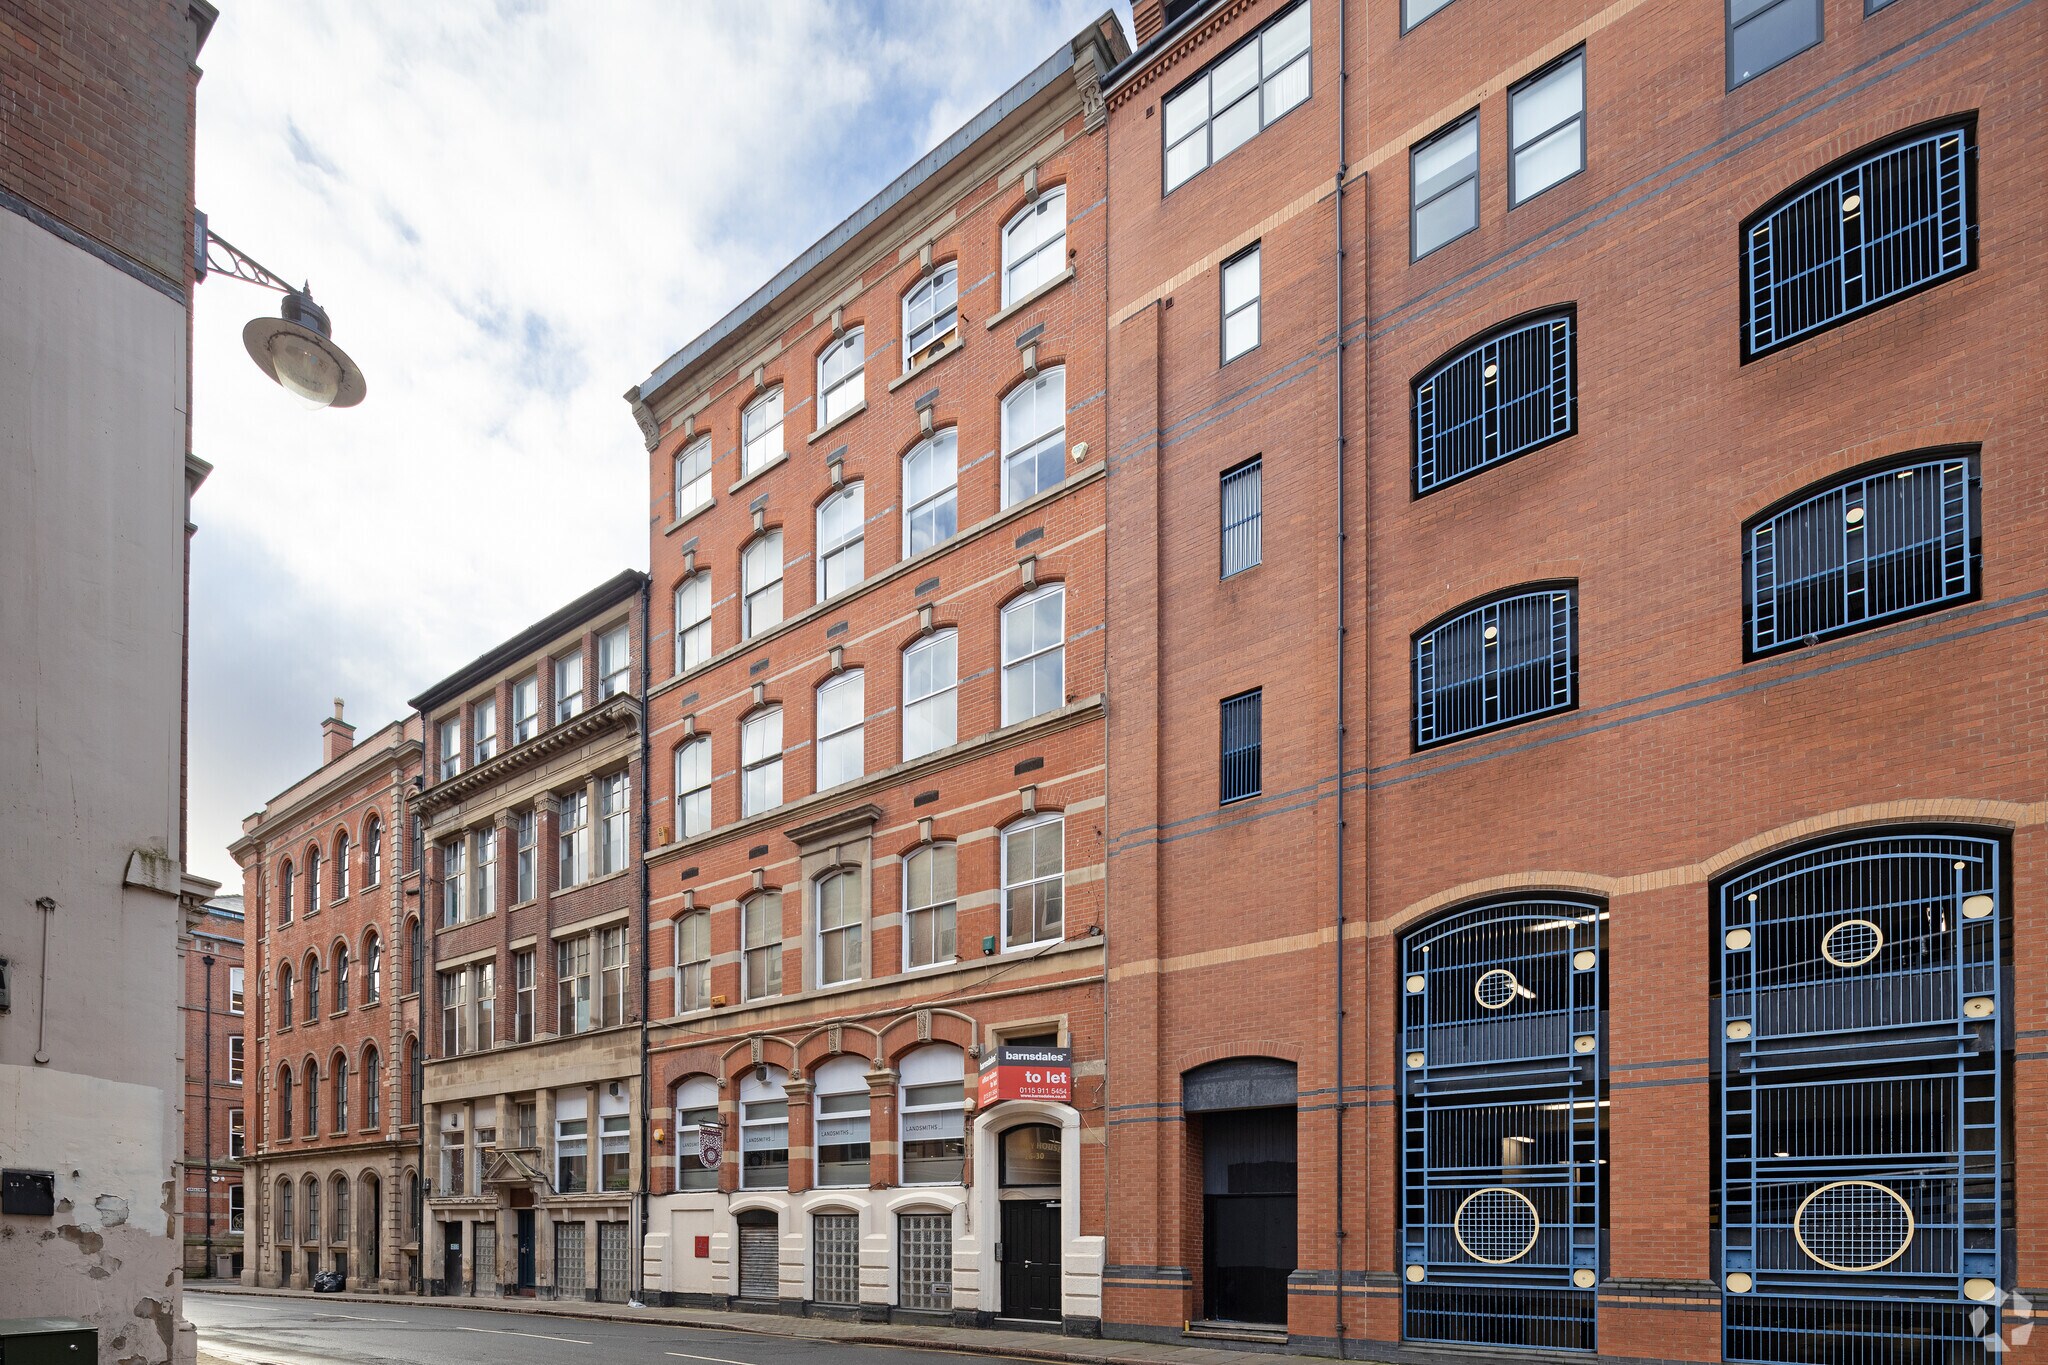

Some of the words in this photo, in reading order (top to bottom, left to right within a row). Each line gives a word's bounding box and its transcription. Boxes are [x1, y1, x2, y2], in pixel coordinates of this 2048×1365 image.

[1025, 1070, 1042, 1083] to
[1046, 1070, 1067, 1084] let
[1019, 1086, 1036, 1094] 0115
[905, 1124, 938, 1132] LANDSMITHS
[821, 1129, 849, 1137] LANDSMITHS
[746, 1136, 771, 1144] LANDSMITHS
